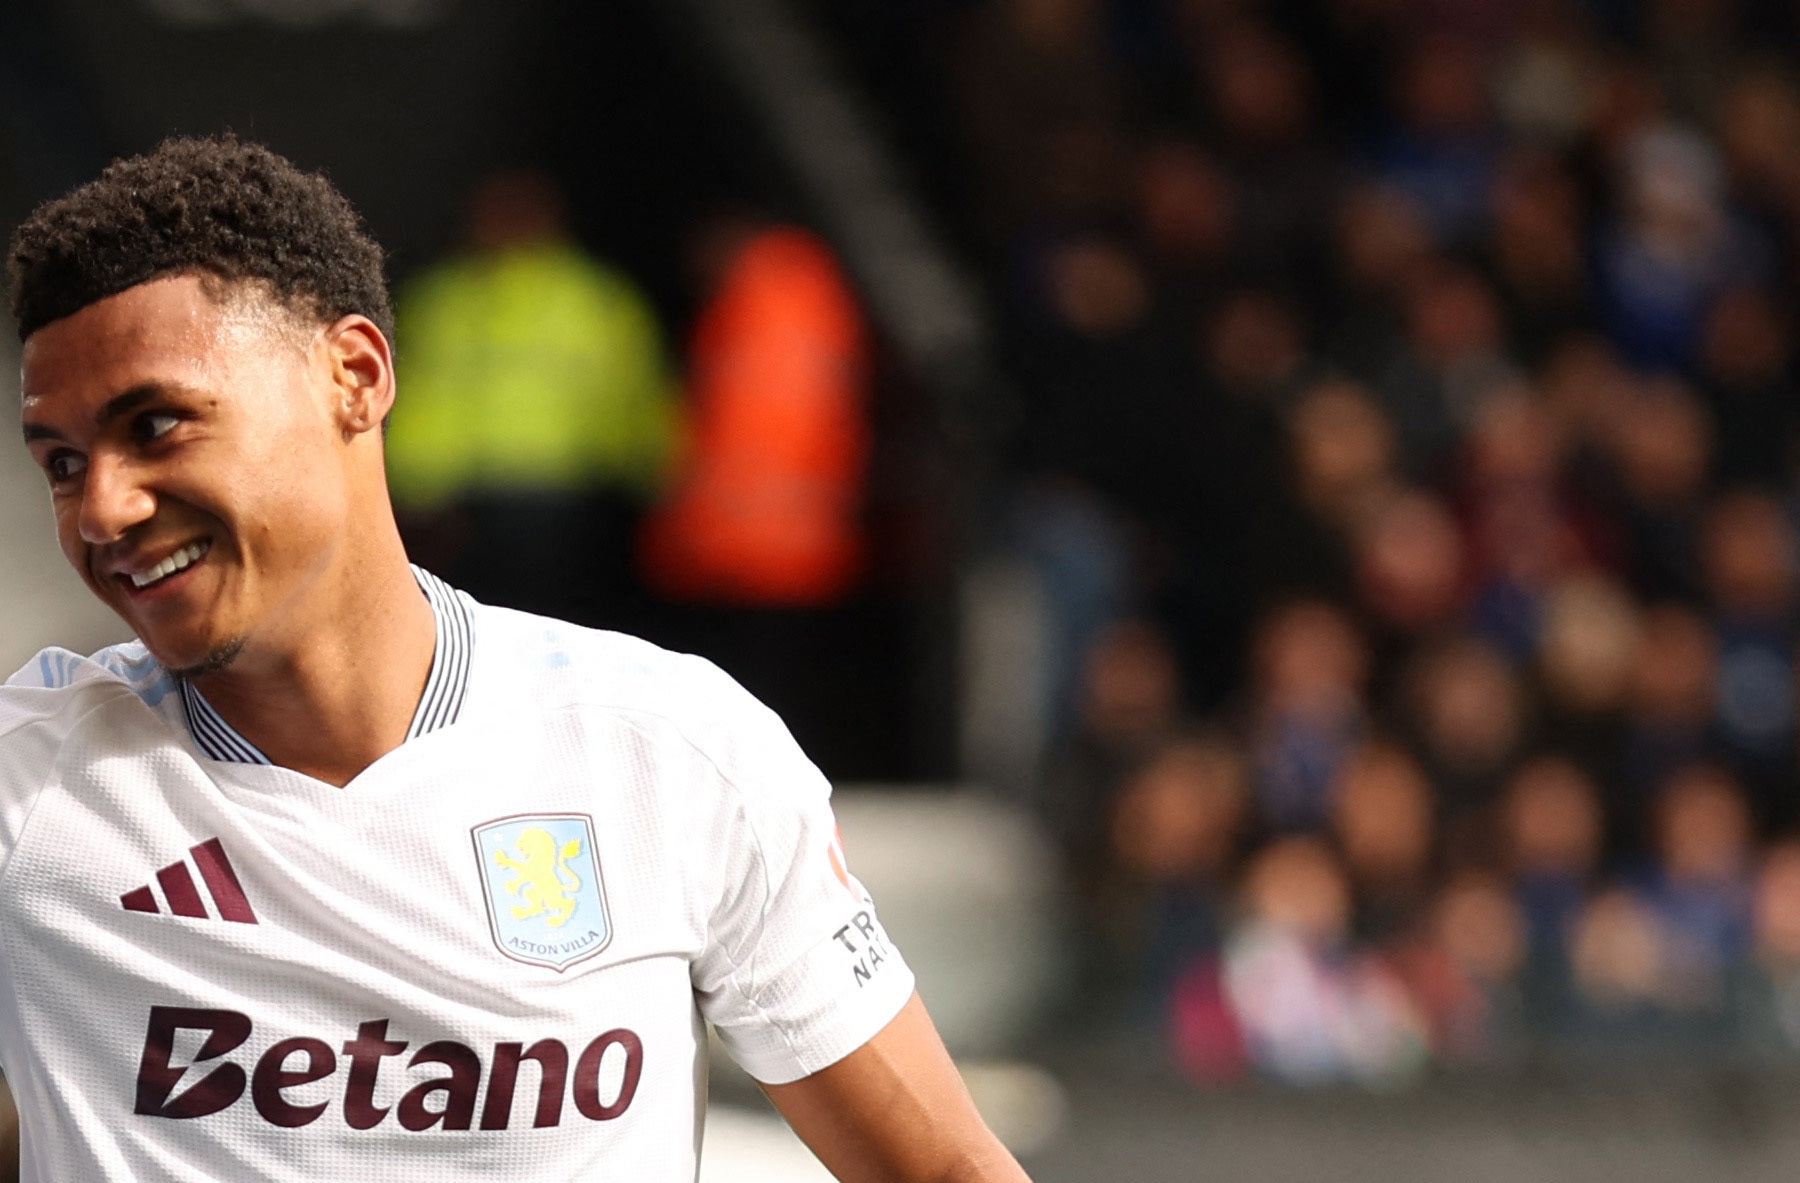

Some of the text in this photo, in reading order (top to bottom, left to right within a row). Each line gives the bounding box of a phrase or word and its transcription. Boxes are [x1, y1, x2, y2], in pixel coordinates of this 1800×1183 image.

[509, 936, 558, 955] ASTON
[560, 930, 600, 953] VILLA
[833, 911, 875, 953] TR
[133, 1005, 643, 1132] Betano
